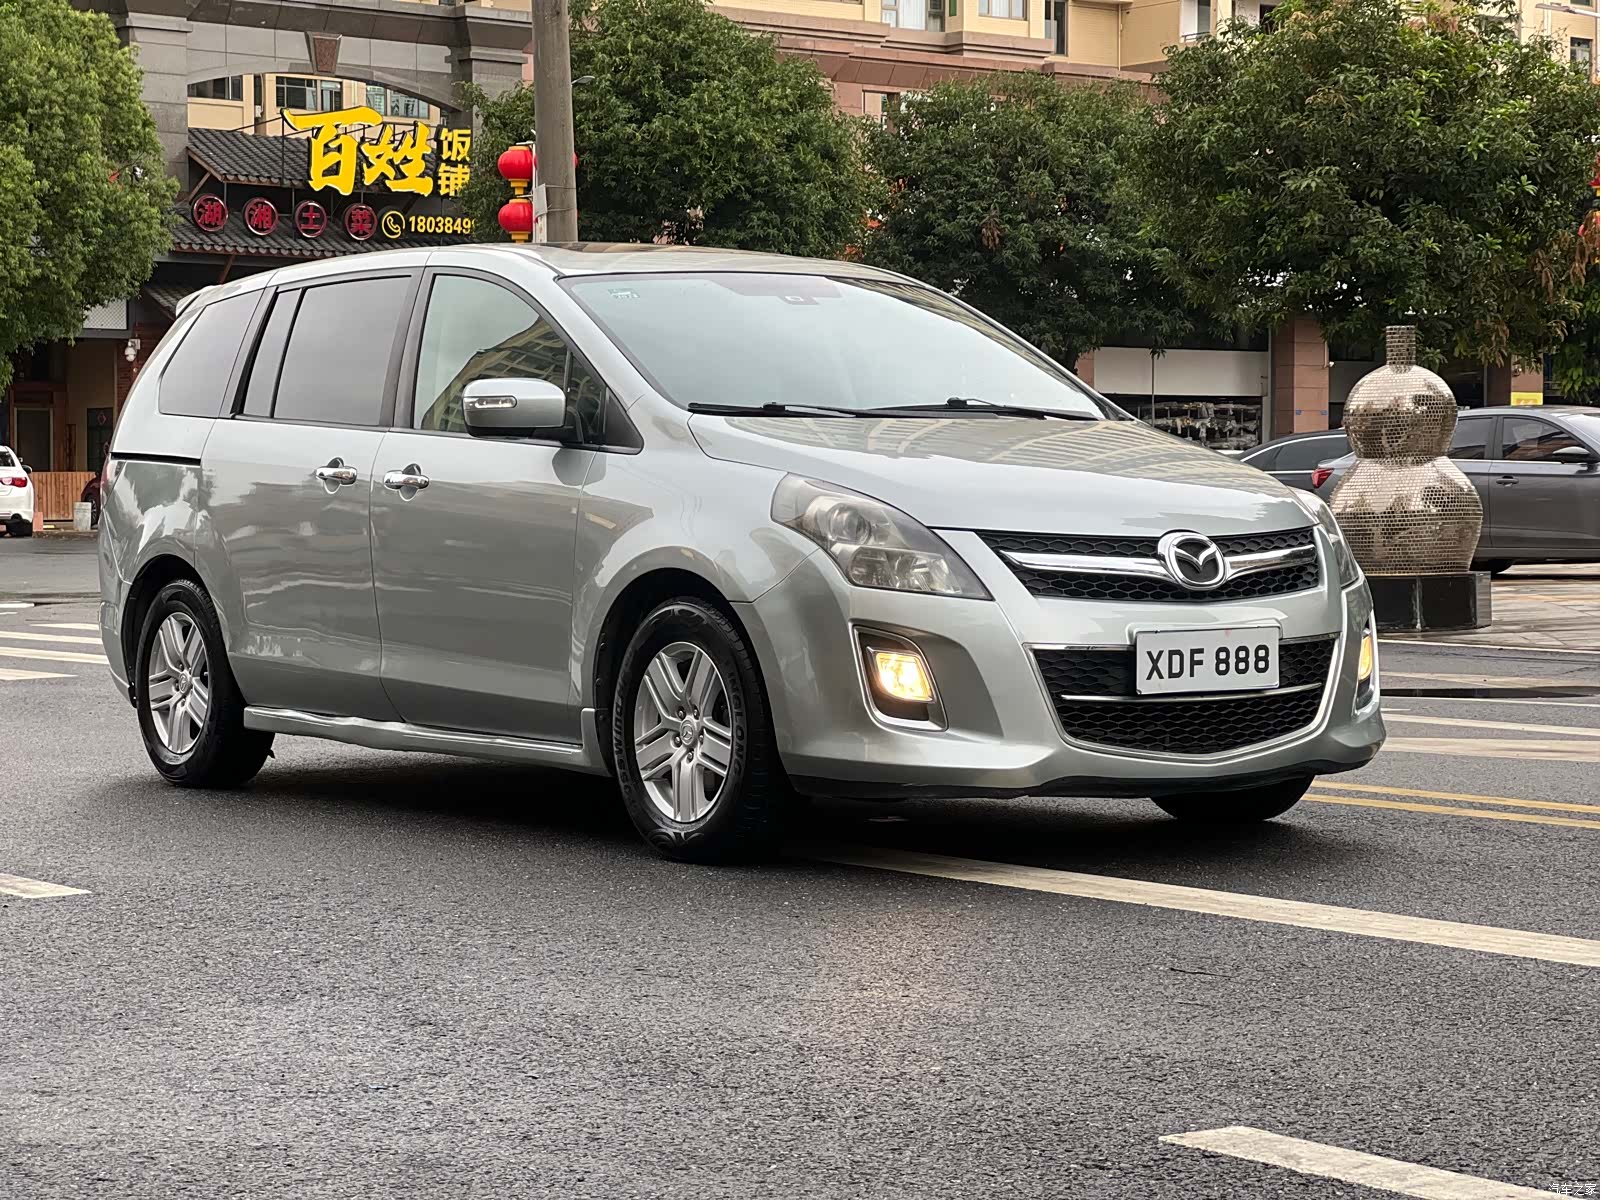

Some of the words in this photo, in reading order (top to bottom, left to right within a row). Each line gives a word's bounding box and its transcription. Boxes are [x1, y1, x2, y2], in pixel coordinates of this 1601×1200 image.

[283, 105, 434, 197] 百姓
[438, 127, 472, 197] 饭铺
[200, 201, 372, 233] 湖湘土菜
[1146, 648, 1205, 681] XDF
[1214, 644, 1270, 676] 888
